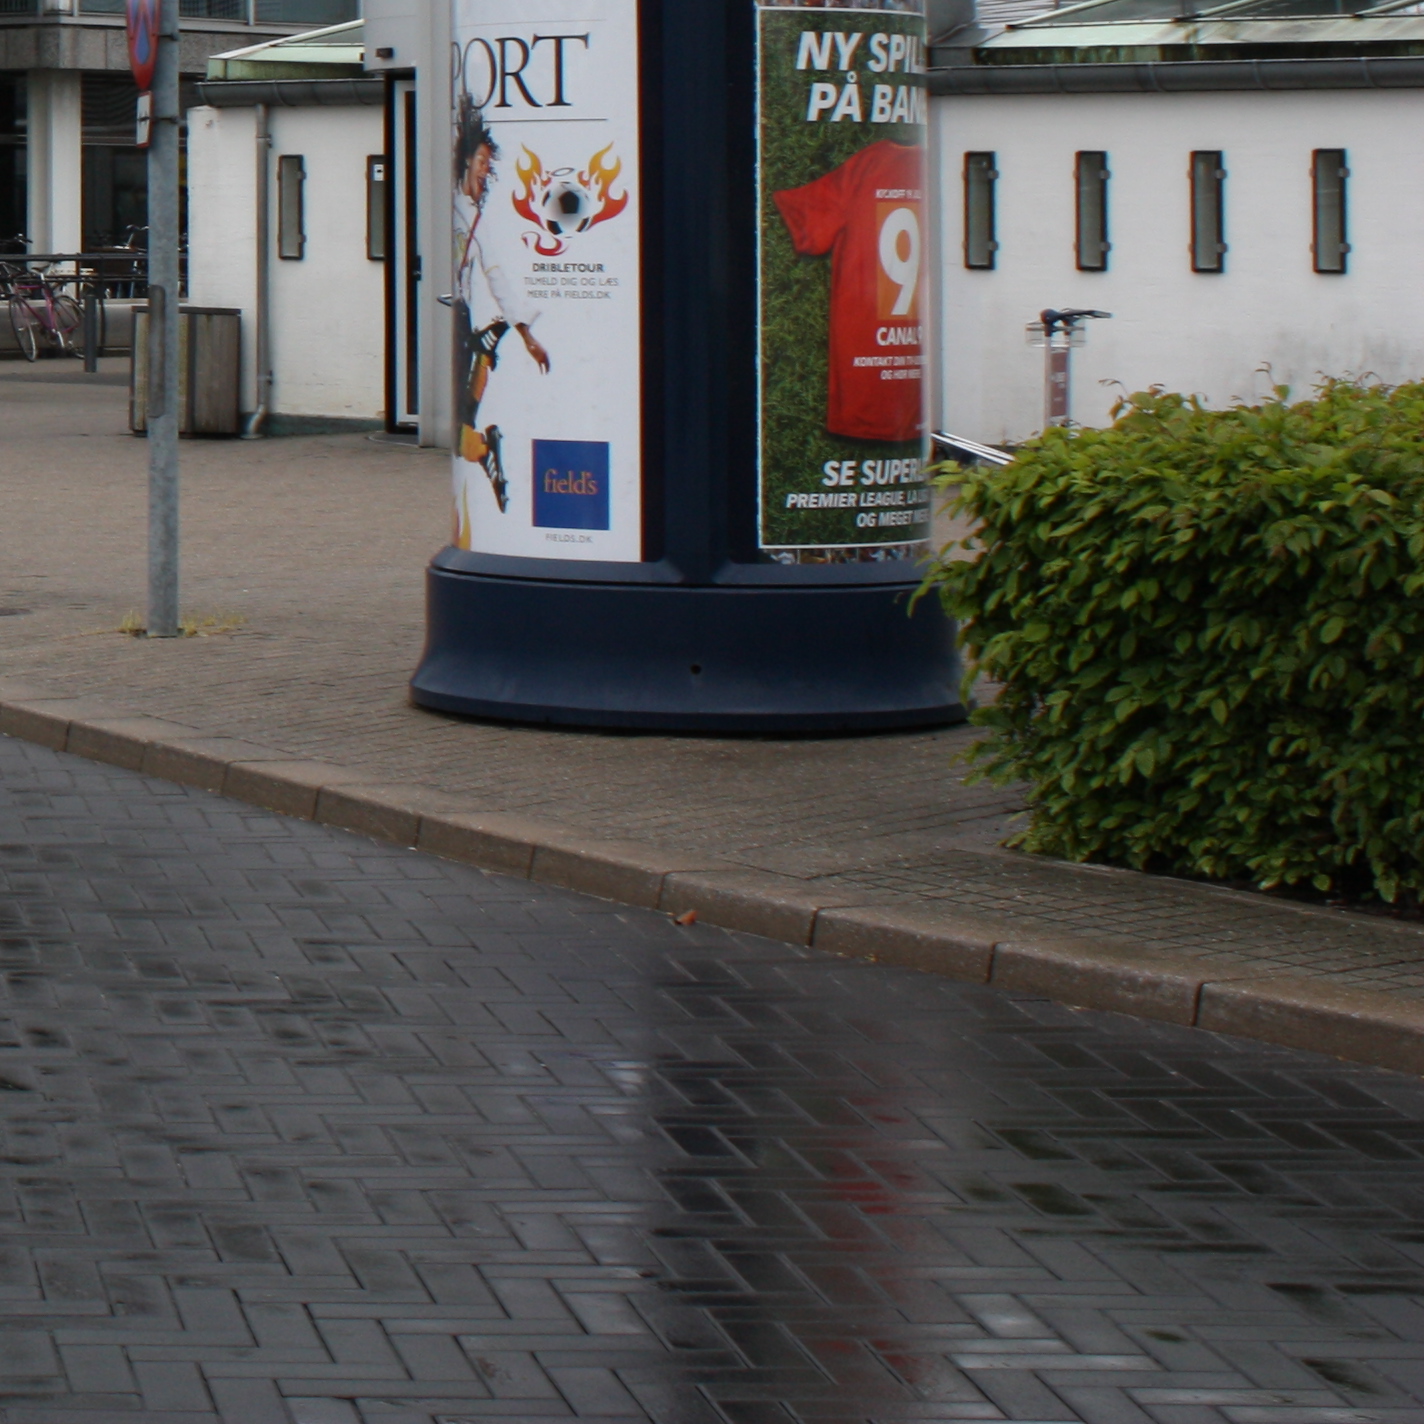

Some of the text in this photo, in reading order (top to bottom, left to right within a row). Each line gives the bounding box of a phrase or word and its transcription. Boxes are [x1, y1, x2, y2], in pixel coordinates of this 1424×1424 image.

[796, 31, 863, 71] NY
[806, 71, 863, 122] PÅ
[532, 263, 604, 273] DRIBLETOUR
[879, 207, 920, 316] 9
[524, 277, 619, 286] TILMELD DIG OG LÆS
[527, 288, 611, 299] MERE PÅ FIELDS.DK
[880, 370, 893, 380] OG
[543, 468, 599, 495] field's
[822, 460, 857, 487] SE
[786, 493, 857, 508] PREMIER
[856, 512, 877, 527] OG
[878, 510, 913, 526] MEGET
